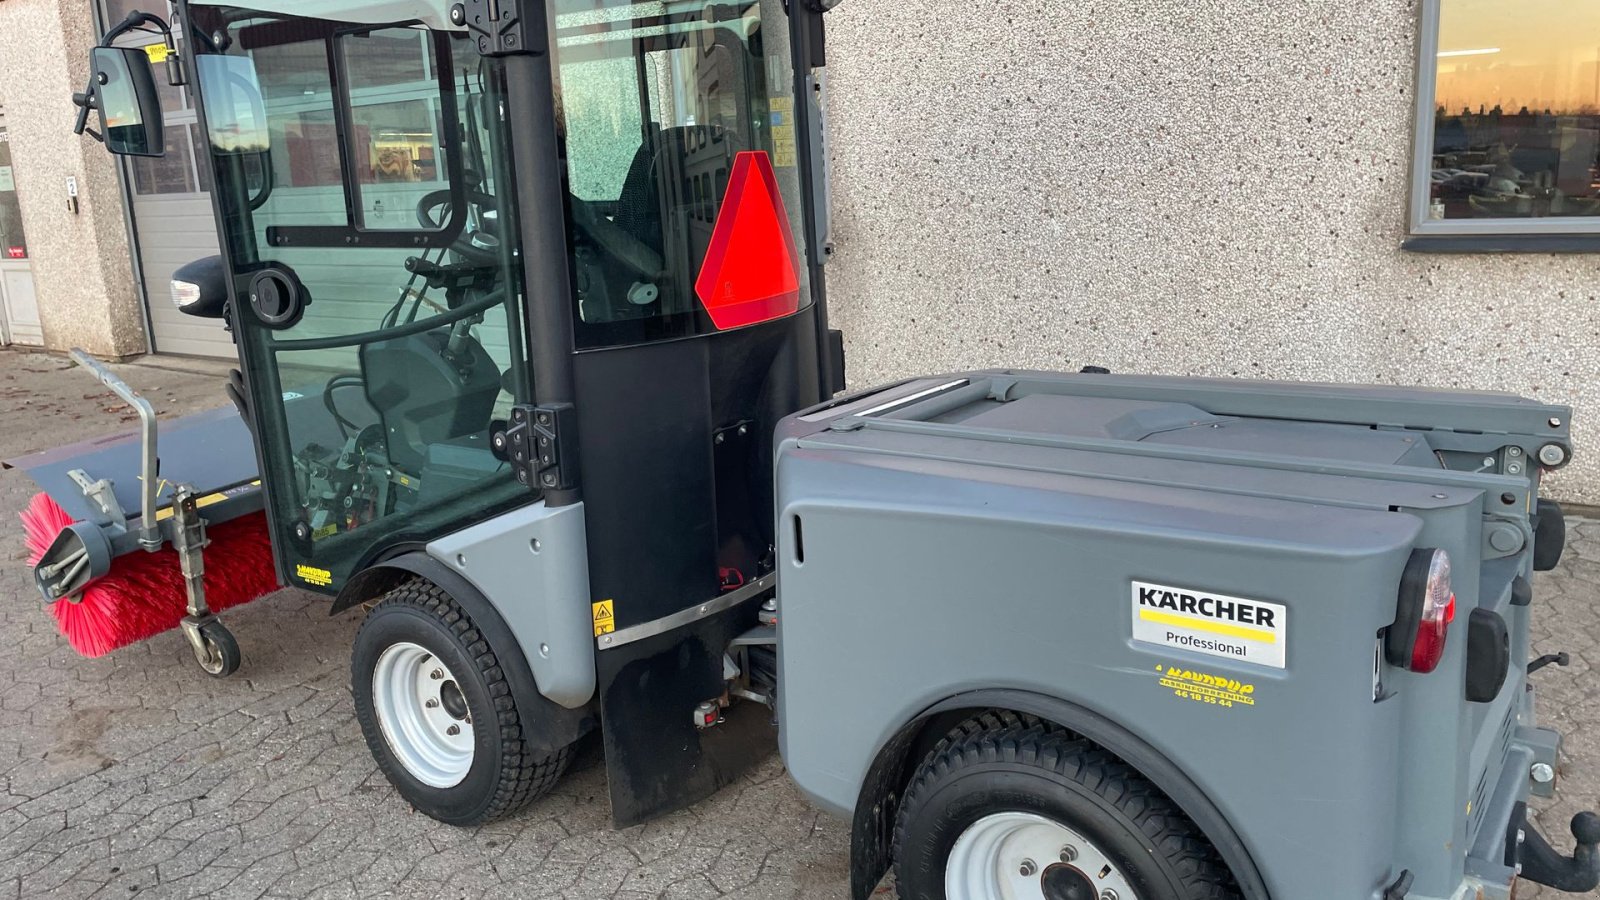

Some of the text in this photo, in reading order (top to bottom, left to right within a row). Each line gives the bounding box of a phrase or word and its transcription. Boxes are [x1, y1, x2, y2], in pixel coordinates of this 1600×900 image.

[1139, 588, 1275, 628] KÄRCHER
[1166, 631, 1247, 657] Professional
[1174, 689, 1233, 708] 46 18 55 44
